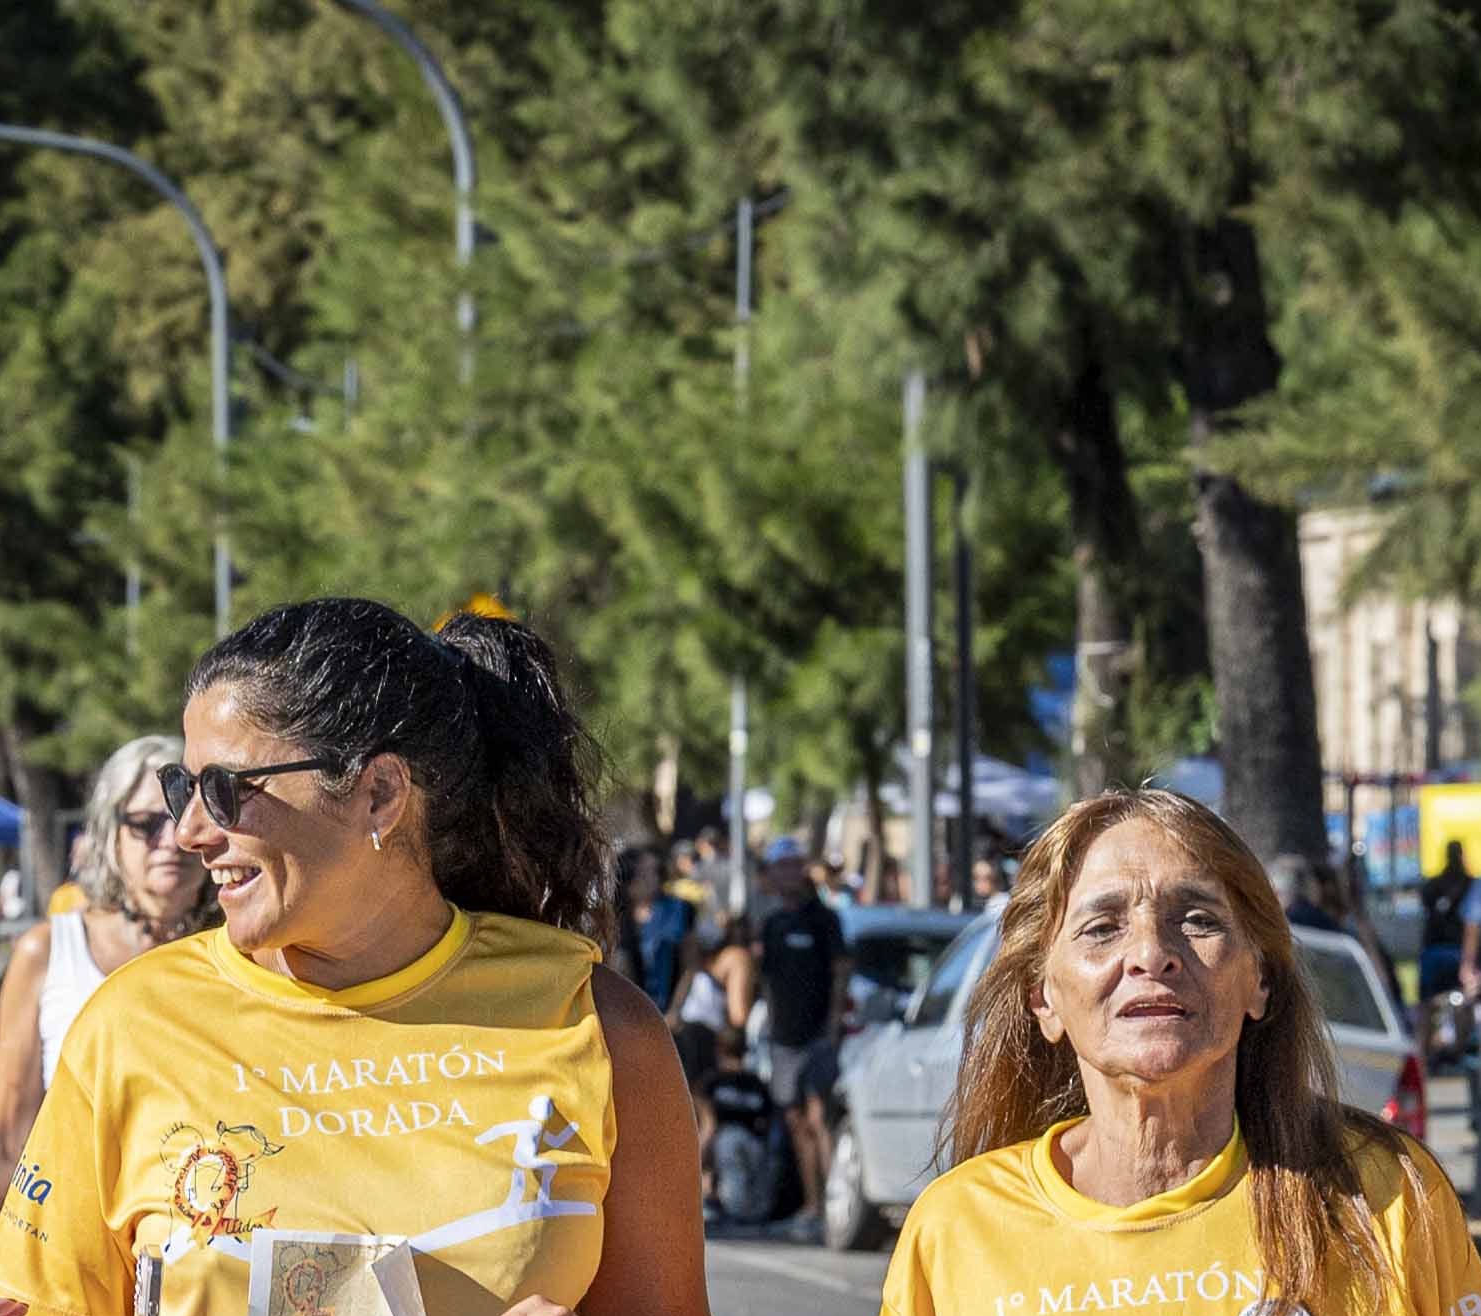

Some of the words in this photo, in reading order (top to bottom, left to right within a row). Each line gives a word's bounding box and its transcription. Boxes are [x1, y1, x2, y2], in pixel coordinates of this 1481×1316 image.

[279, 1044, 505, 1095] MARATÓN
[279, 1098, 474, 1138] DORADA
[1038, 1261, 1265, 1316] MARATÓN
